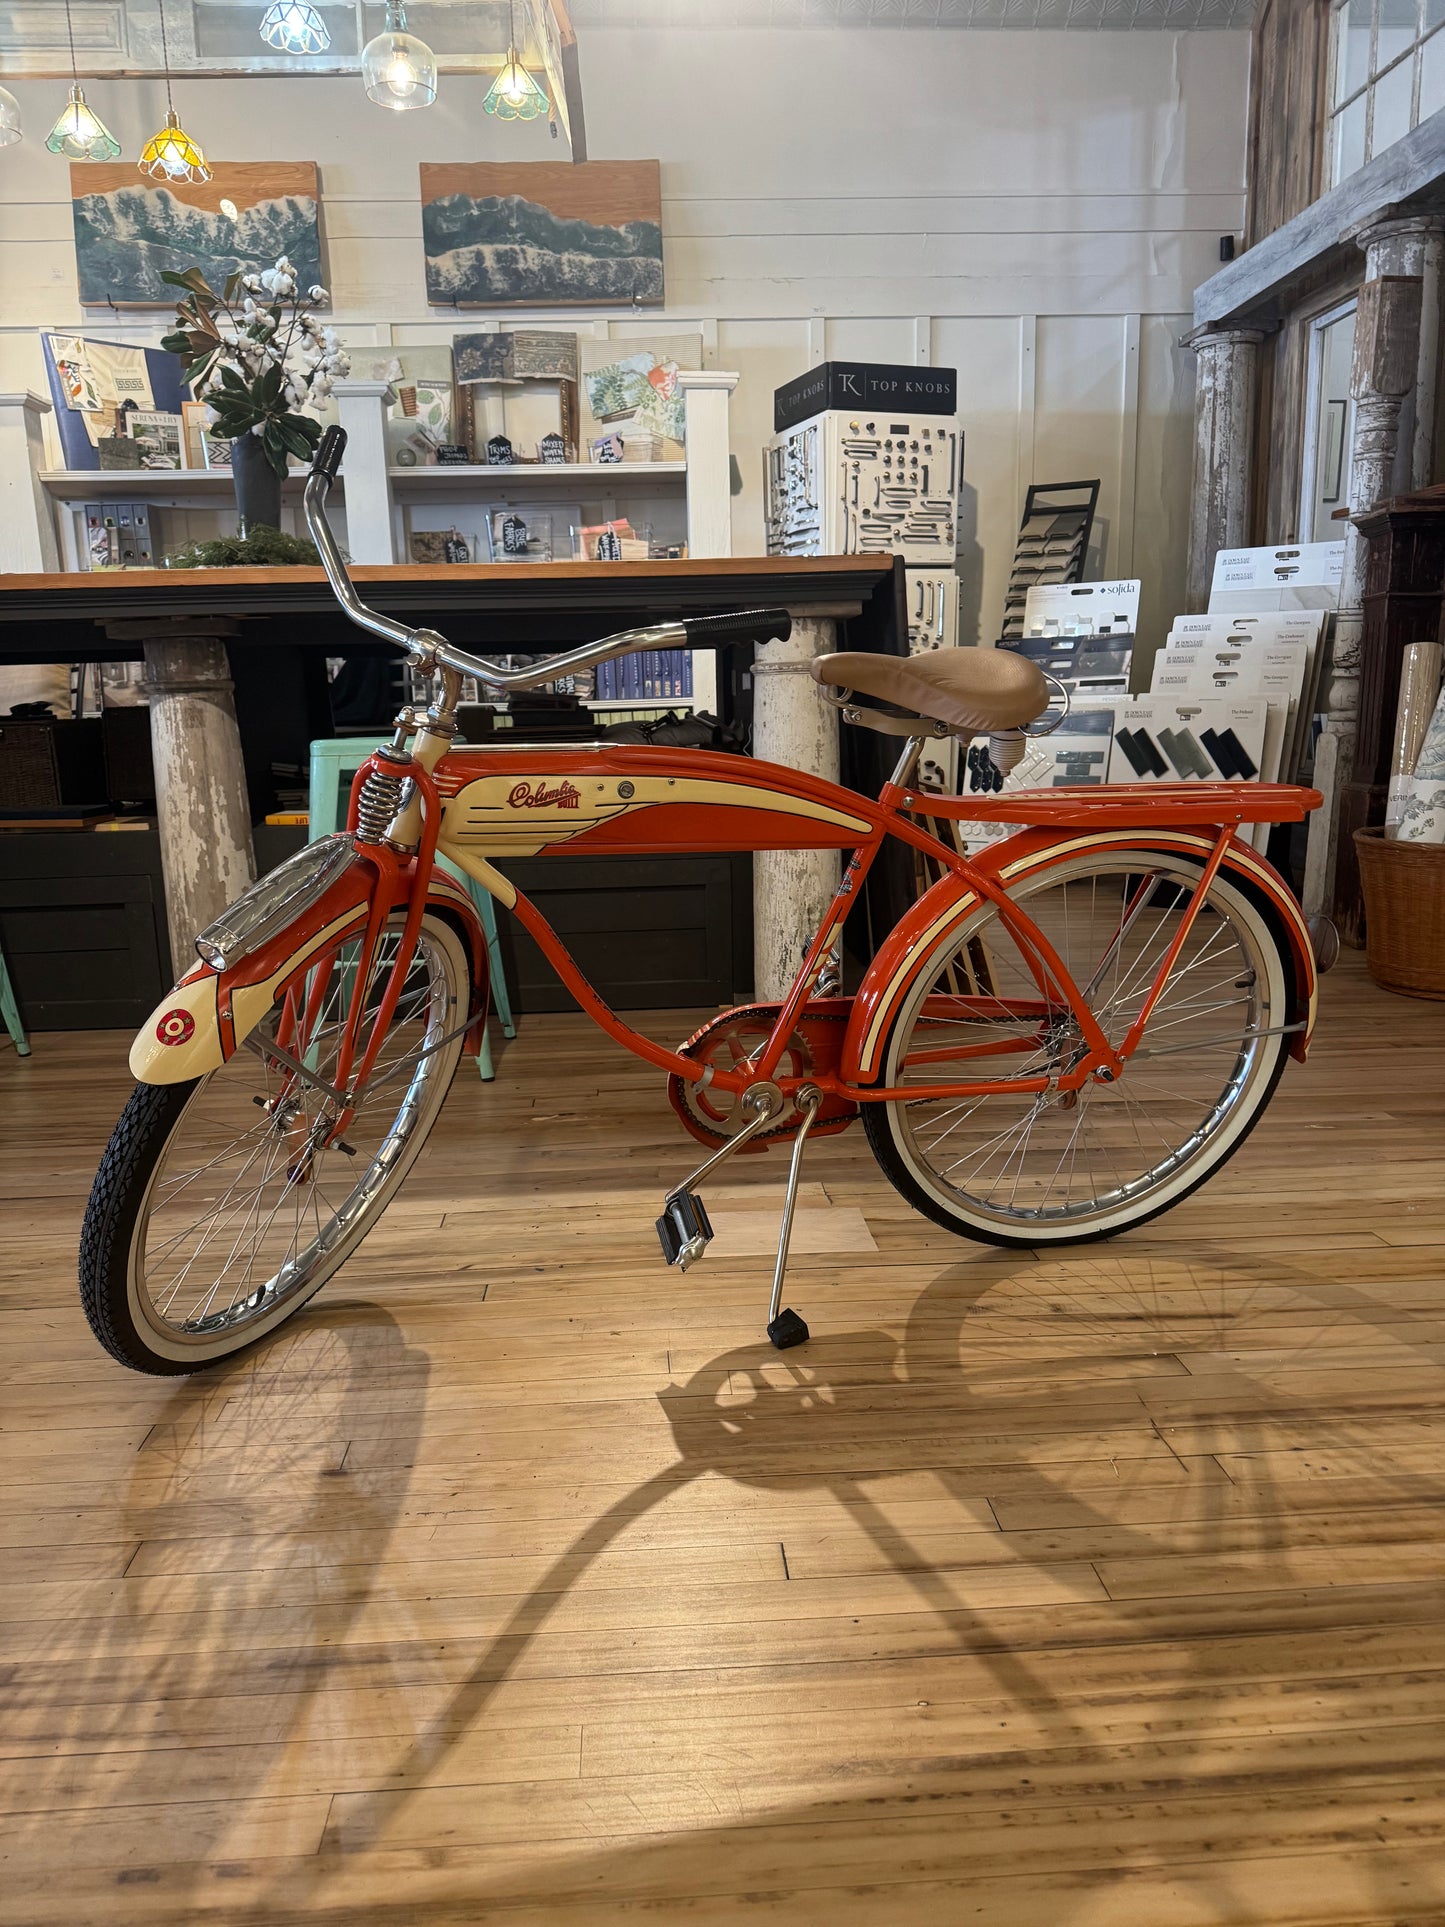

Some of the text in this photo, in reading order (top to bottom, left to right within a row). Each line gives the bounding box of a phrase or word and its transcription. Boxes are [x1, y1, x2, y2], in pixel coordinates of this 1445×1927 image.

[788, 379, 825, 407] TOP KNOBS
[870, 380, 951, 394] TOP KNOBS
[488, 443, 511, 455] TRIMS
[542, 440, 564, 448] MIXED
[505, 780, 580, 808] Columbia
